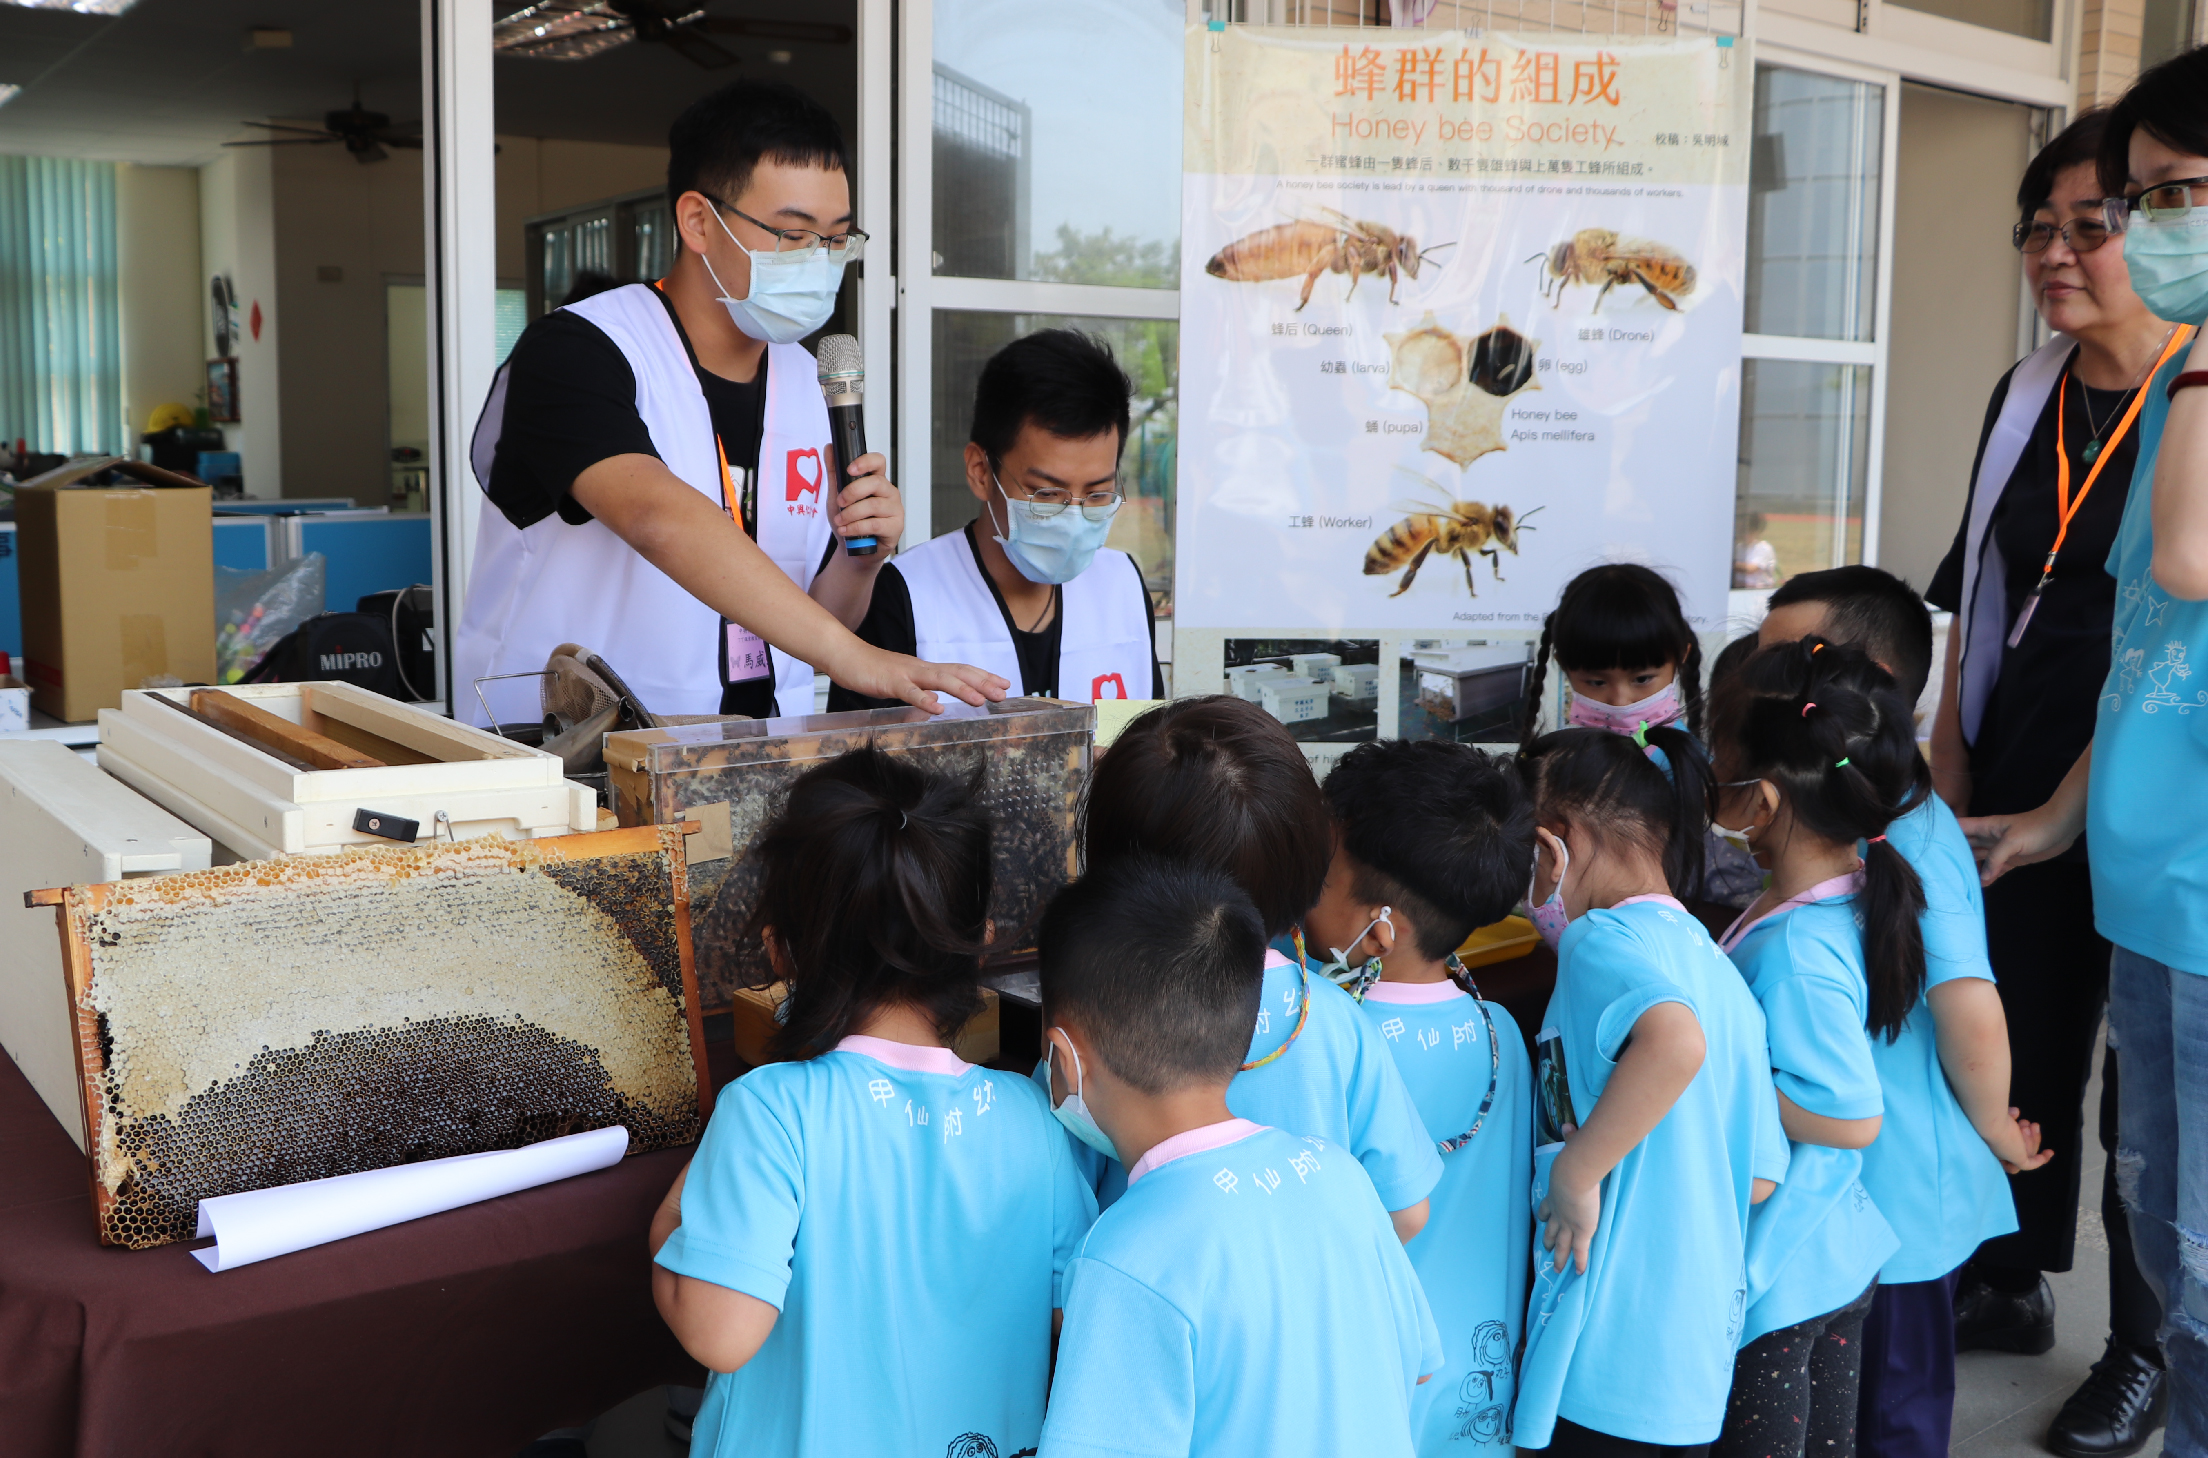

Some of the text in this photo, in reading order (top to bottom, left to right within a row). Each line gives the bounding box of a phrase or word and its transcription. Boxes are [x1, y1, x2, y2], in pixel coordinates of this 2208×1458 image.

[1333, 43, 1621, 107] 蜂群的組成
[1331, 111, 1618, 151] Honey bee Society
[1276, 180, 1684, 197] A honey bee society is lead by a queen with thousand of drone and thousands of workers.
[1271, 322, 1353, 337] 蜂后 (Queen)
[1577, 328, 1655, 342] 雄蜂 (Drone)
[1320, 360, 1391, 374] 幼蟲 (larva)
[1538, 358, 1588, 373] 卵 (egg)
[1511, 409, 1578, 422] Honey bee
[1365, 420, 1423, 435] 蛹 (pupa)
[1510, 429, 1595, 442] Apis mellifera
[1288, 515, 1373, 529] 工蜂 (Worker)
[1453, 611, 1494, 622] Adapted
[1498, 611, 1521, 622] from
[1523, 612, 1539, 622] the
[320, 646, 383, 671] MIPRO
[868, 1079, 997, 1145] 甲仙附幼
